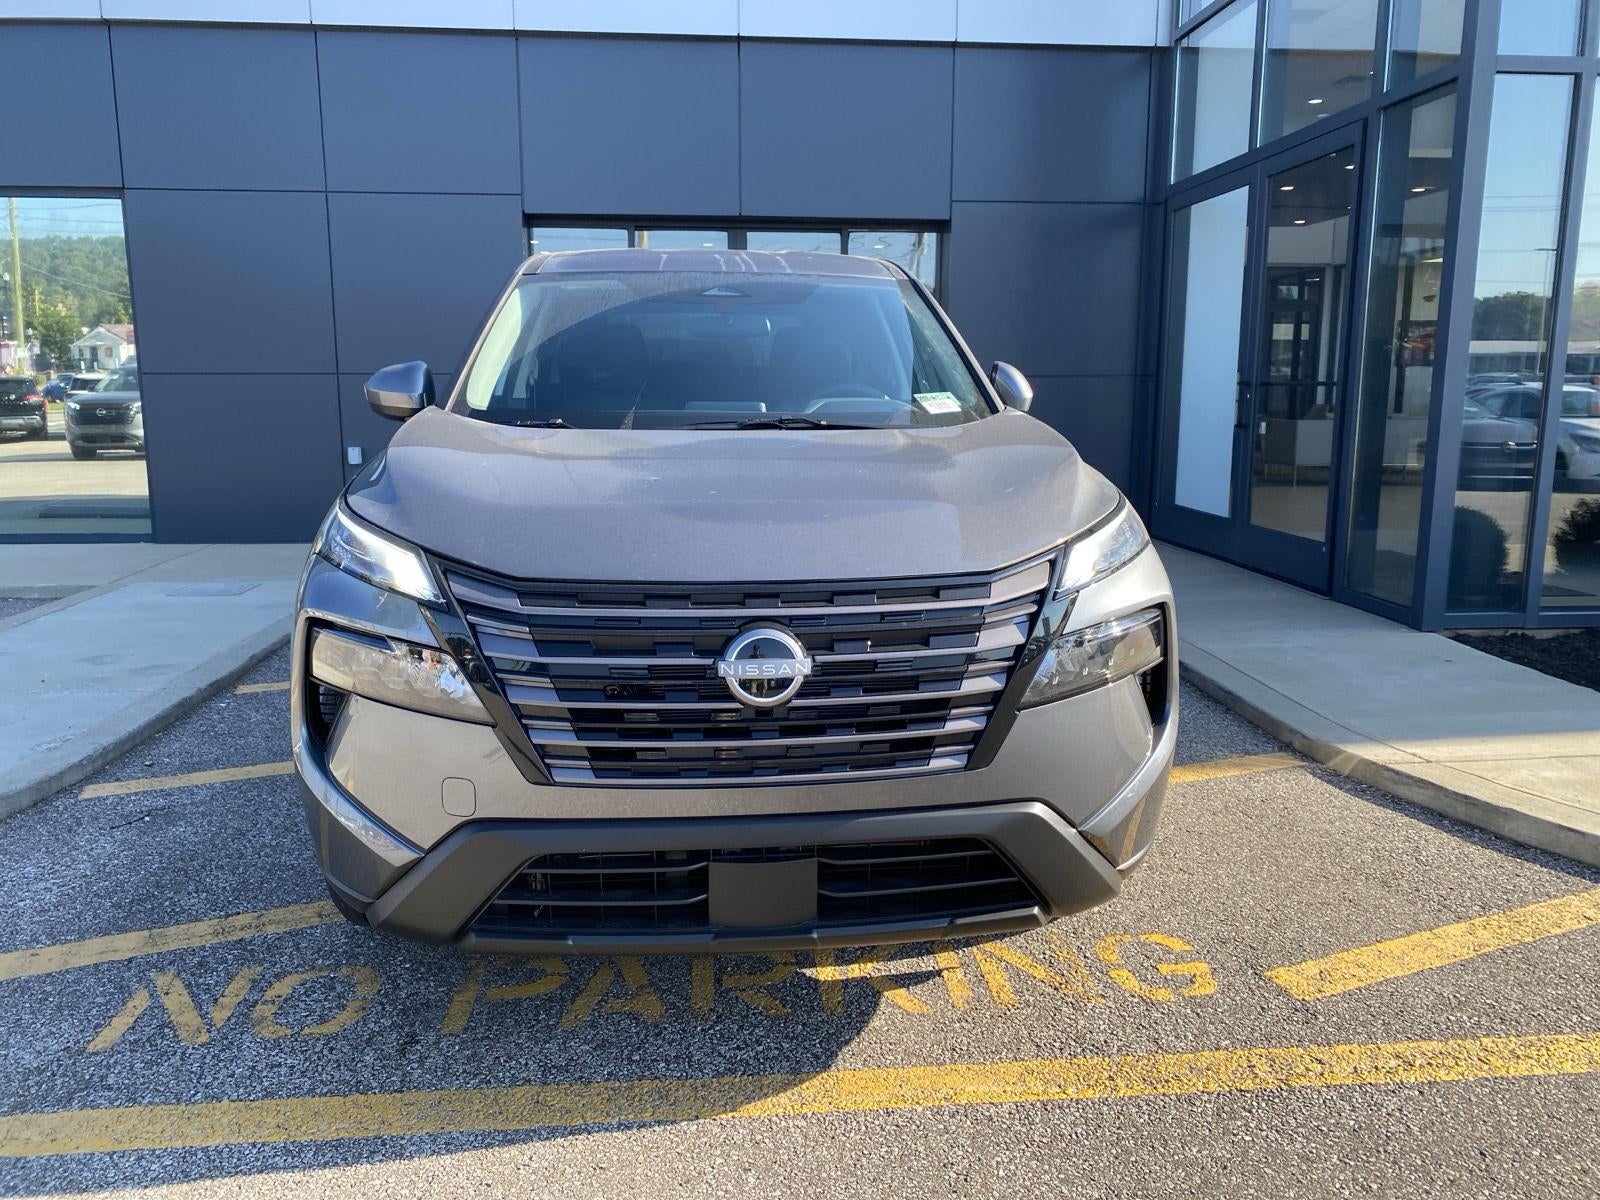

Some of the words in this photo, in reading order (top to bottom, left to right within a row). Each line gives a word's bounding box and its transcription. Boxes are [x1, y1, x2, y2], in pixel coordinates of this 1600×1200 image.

[720, 662, 808, 676] NISSAN
[86, 964, 381, 1053] NO
[441, 932, 1217, 1035] PARKING
